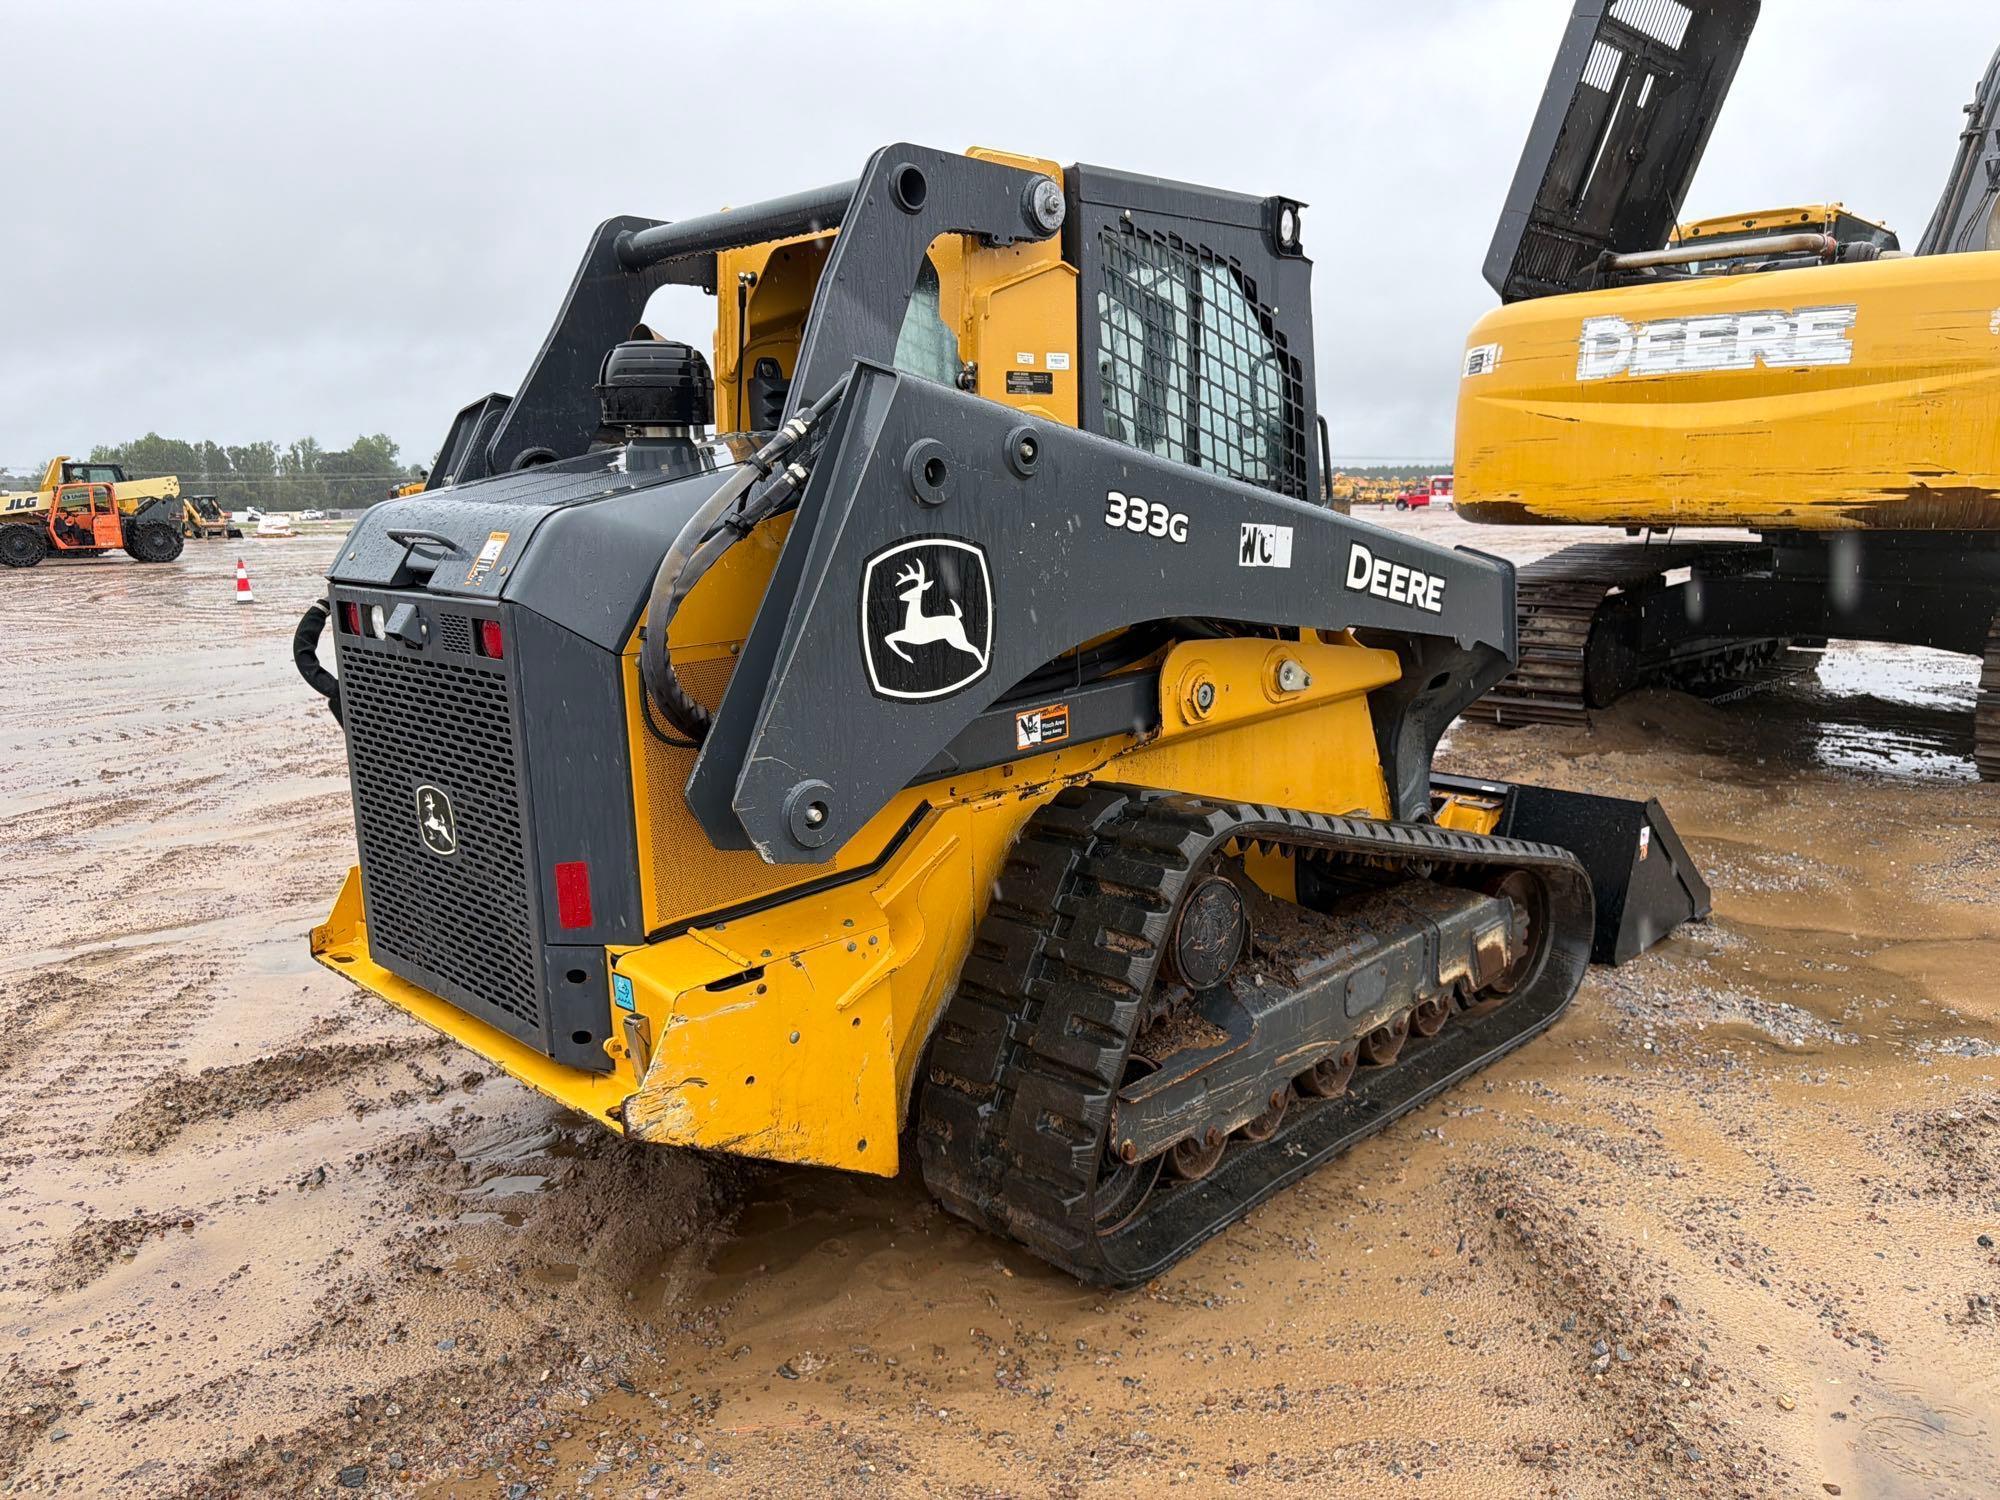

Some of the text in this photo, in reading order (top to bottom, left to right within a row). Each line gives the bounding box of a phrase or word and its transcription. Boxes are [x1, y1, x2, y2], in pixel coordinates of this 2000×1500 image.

[1576, 304, 1857, 380] DEERE
[5, 496, 38, 511] JLG
[1105, 491, 1189, 543] 333G
[1346, 543, 1446, 613] DEERE
